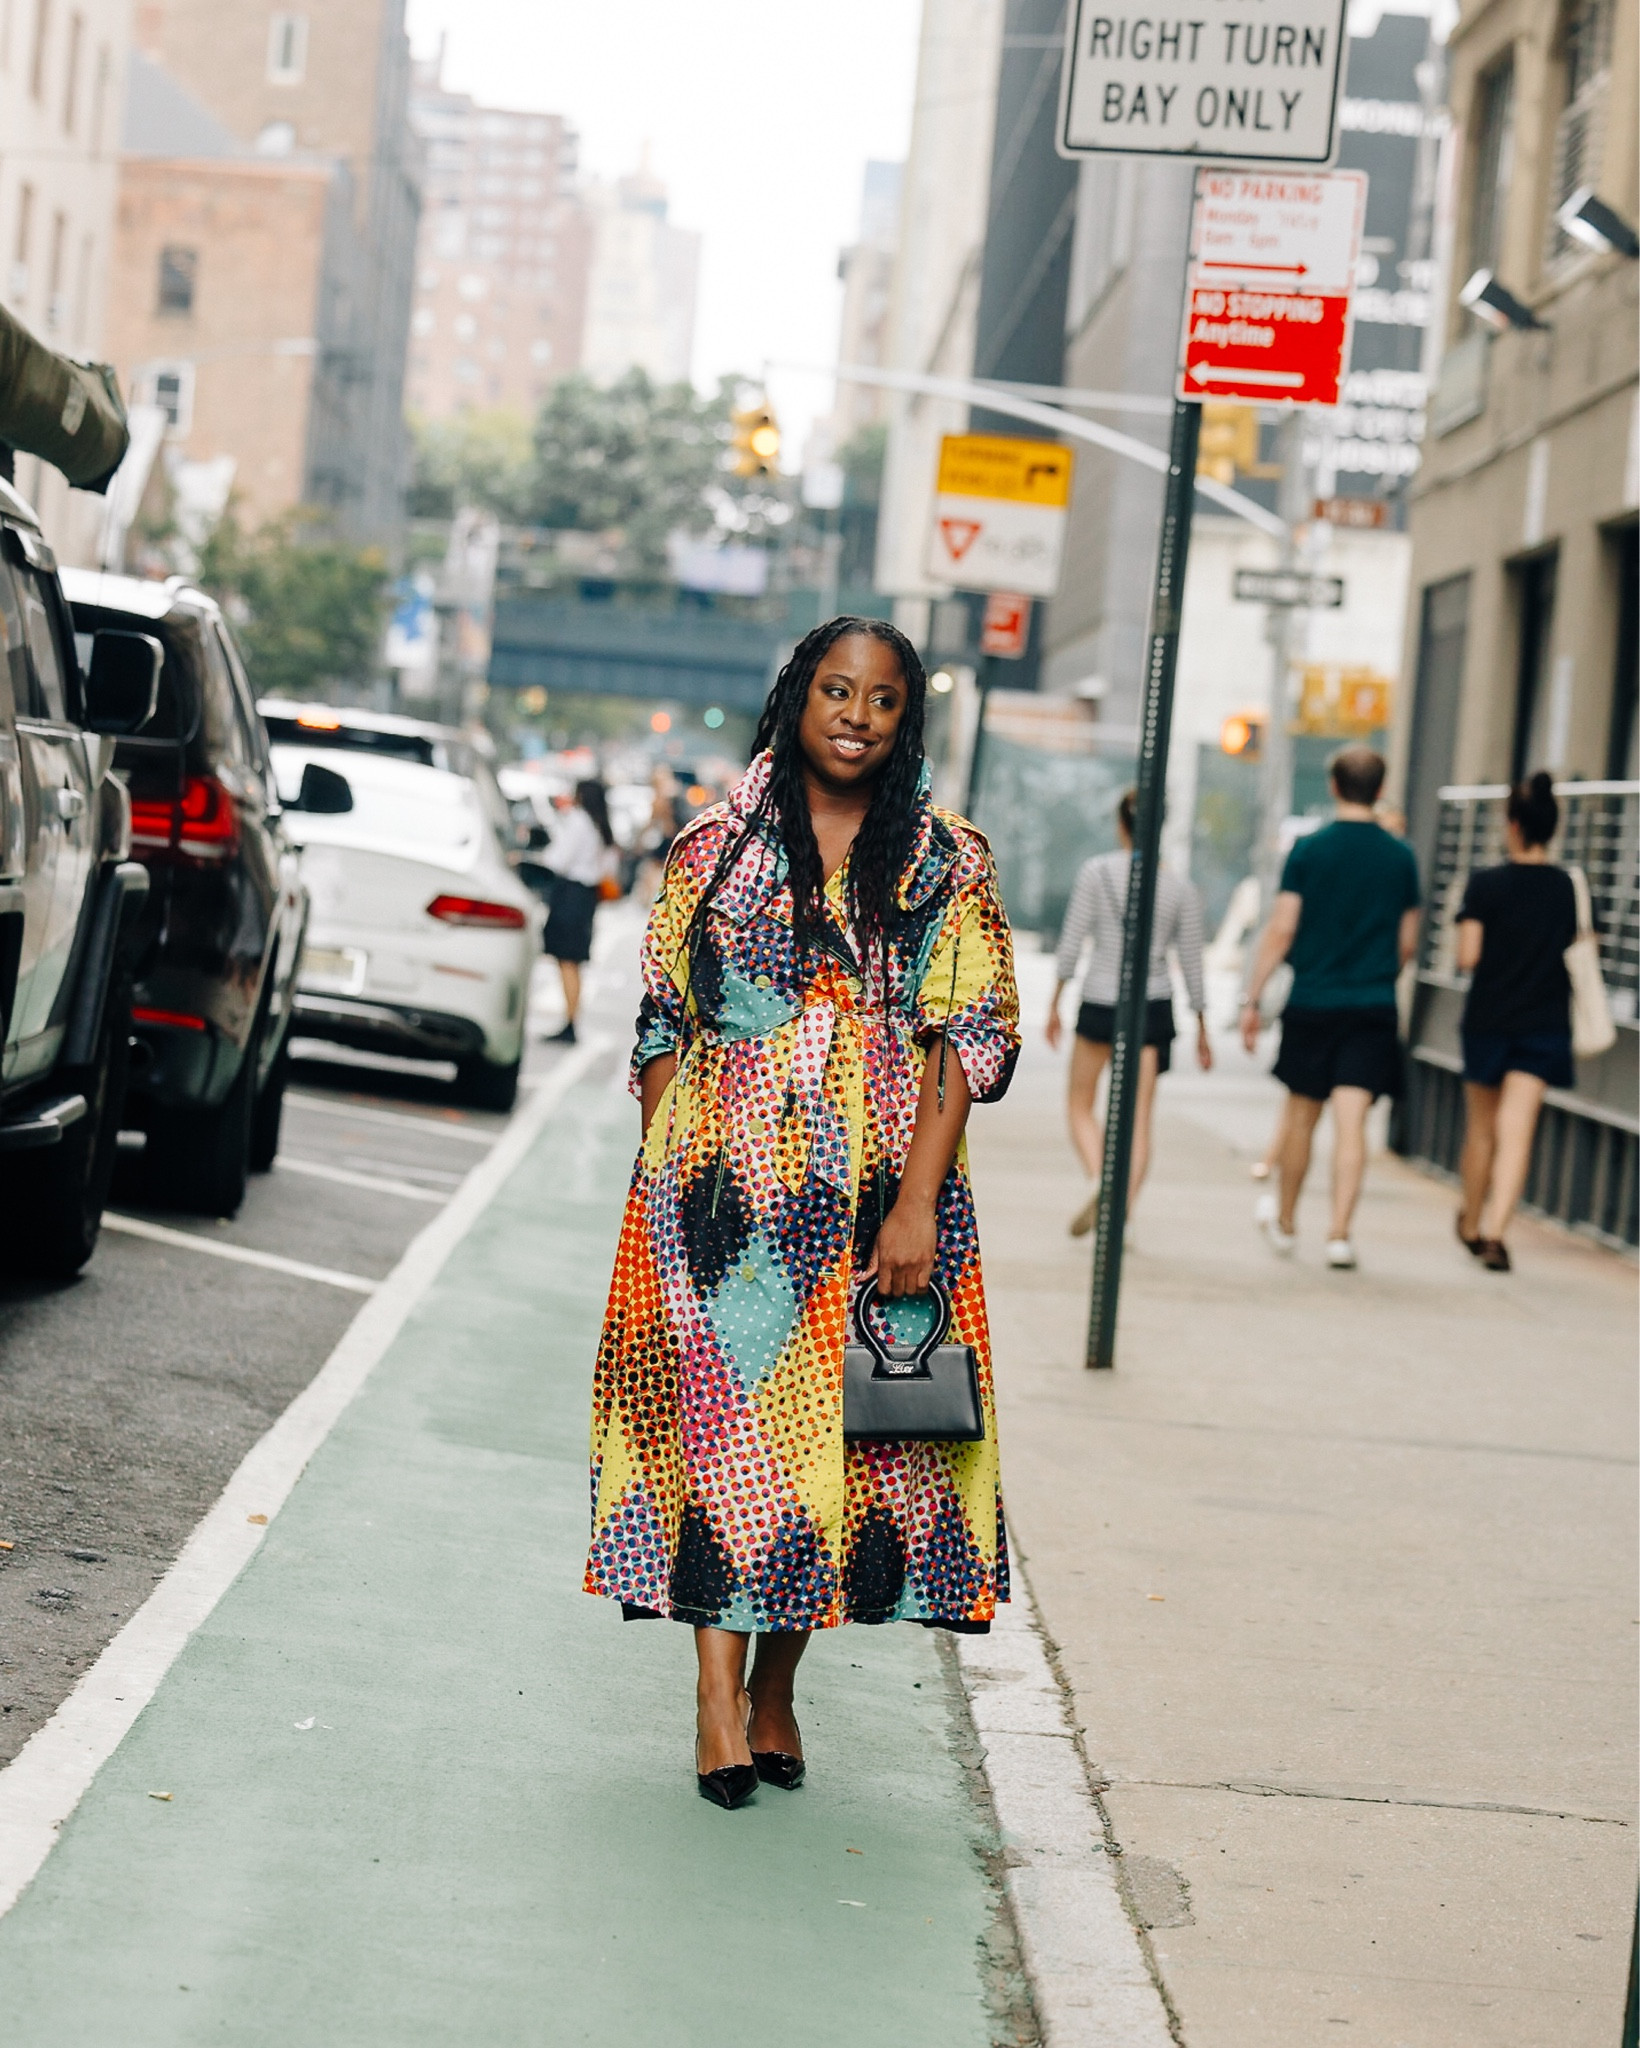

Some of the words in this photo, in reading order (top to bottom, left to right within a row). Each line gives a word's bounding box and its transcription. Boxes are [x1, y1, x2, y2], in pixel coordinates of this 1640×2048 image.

[1091, 18, 1203, 63] RIGHT
[1224, 23, 1325, 67] TURN
[1103, 83, 1178, 124] BAY
[1196, 86, 1301, 131] ONLY
[1209, 179, 1233, 199] NO
[1240, 180, 1323, 205] PARKING
[1194, 291, 1226, 317] NO
[1226, 292, 1325, 324] STOPPING
[1192, 317, 1276, 349] Anytime
